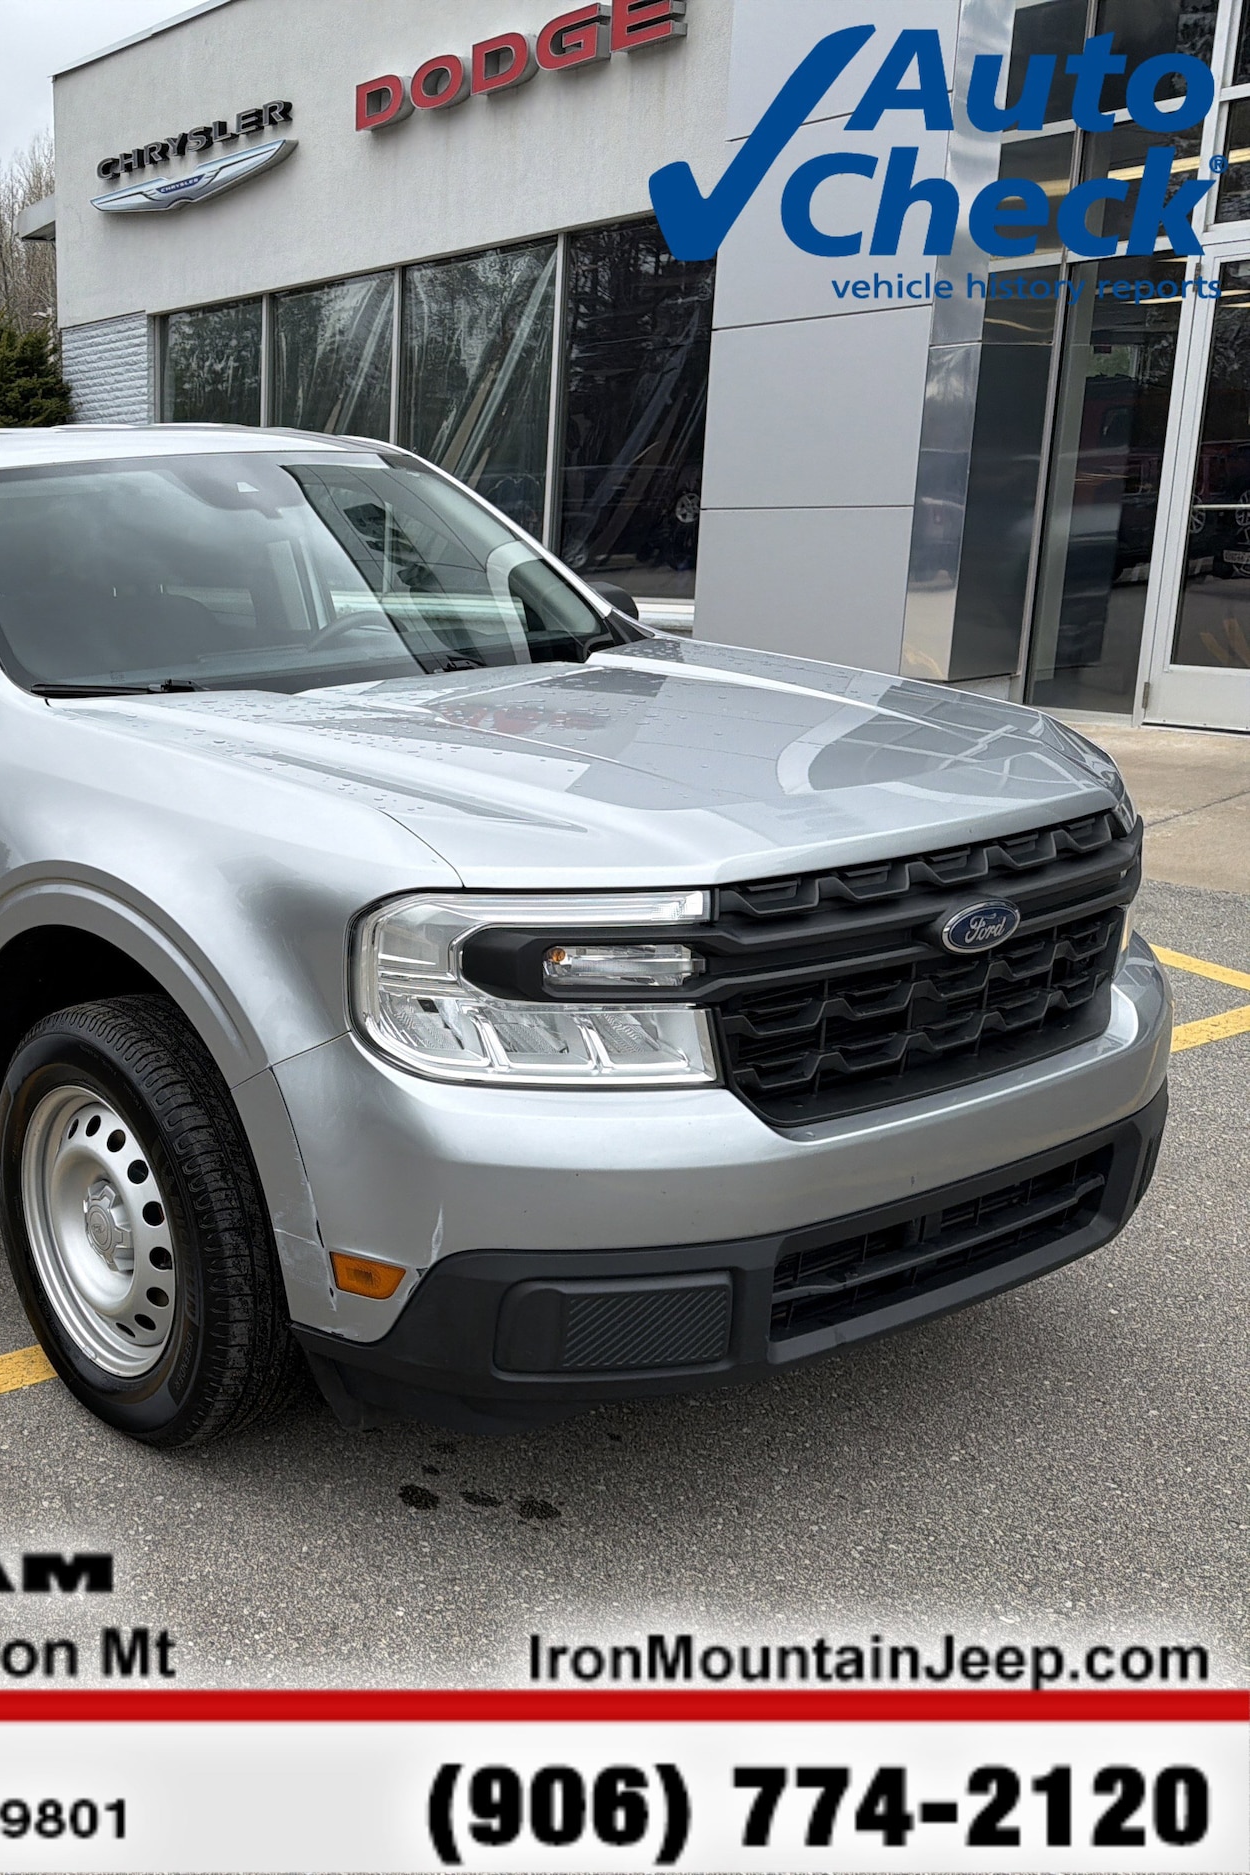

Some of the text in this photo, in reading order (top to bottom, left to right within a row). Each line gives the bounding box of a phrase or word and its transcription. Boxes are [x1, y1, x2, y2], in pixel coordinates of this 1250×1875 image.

[355, 0, 684, 131] DODGE
[96, 100, 293, 180] CHRYSLER
[160, 177, 200, 193] CHRYSLER
[965, 913, 1006, 943] Ford
[174, 1331, 194, 1391] DEFENDER
